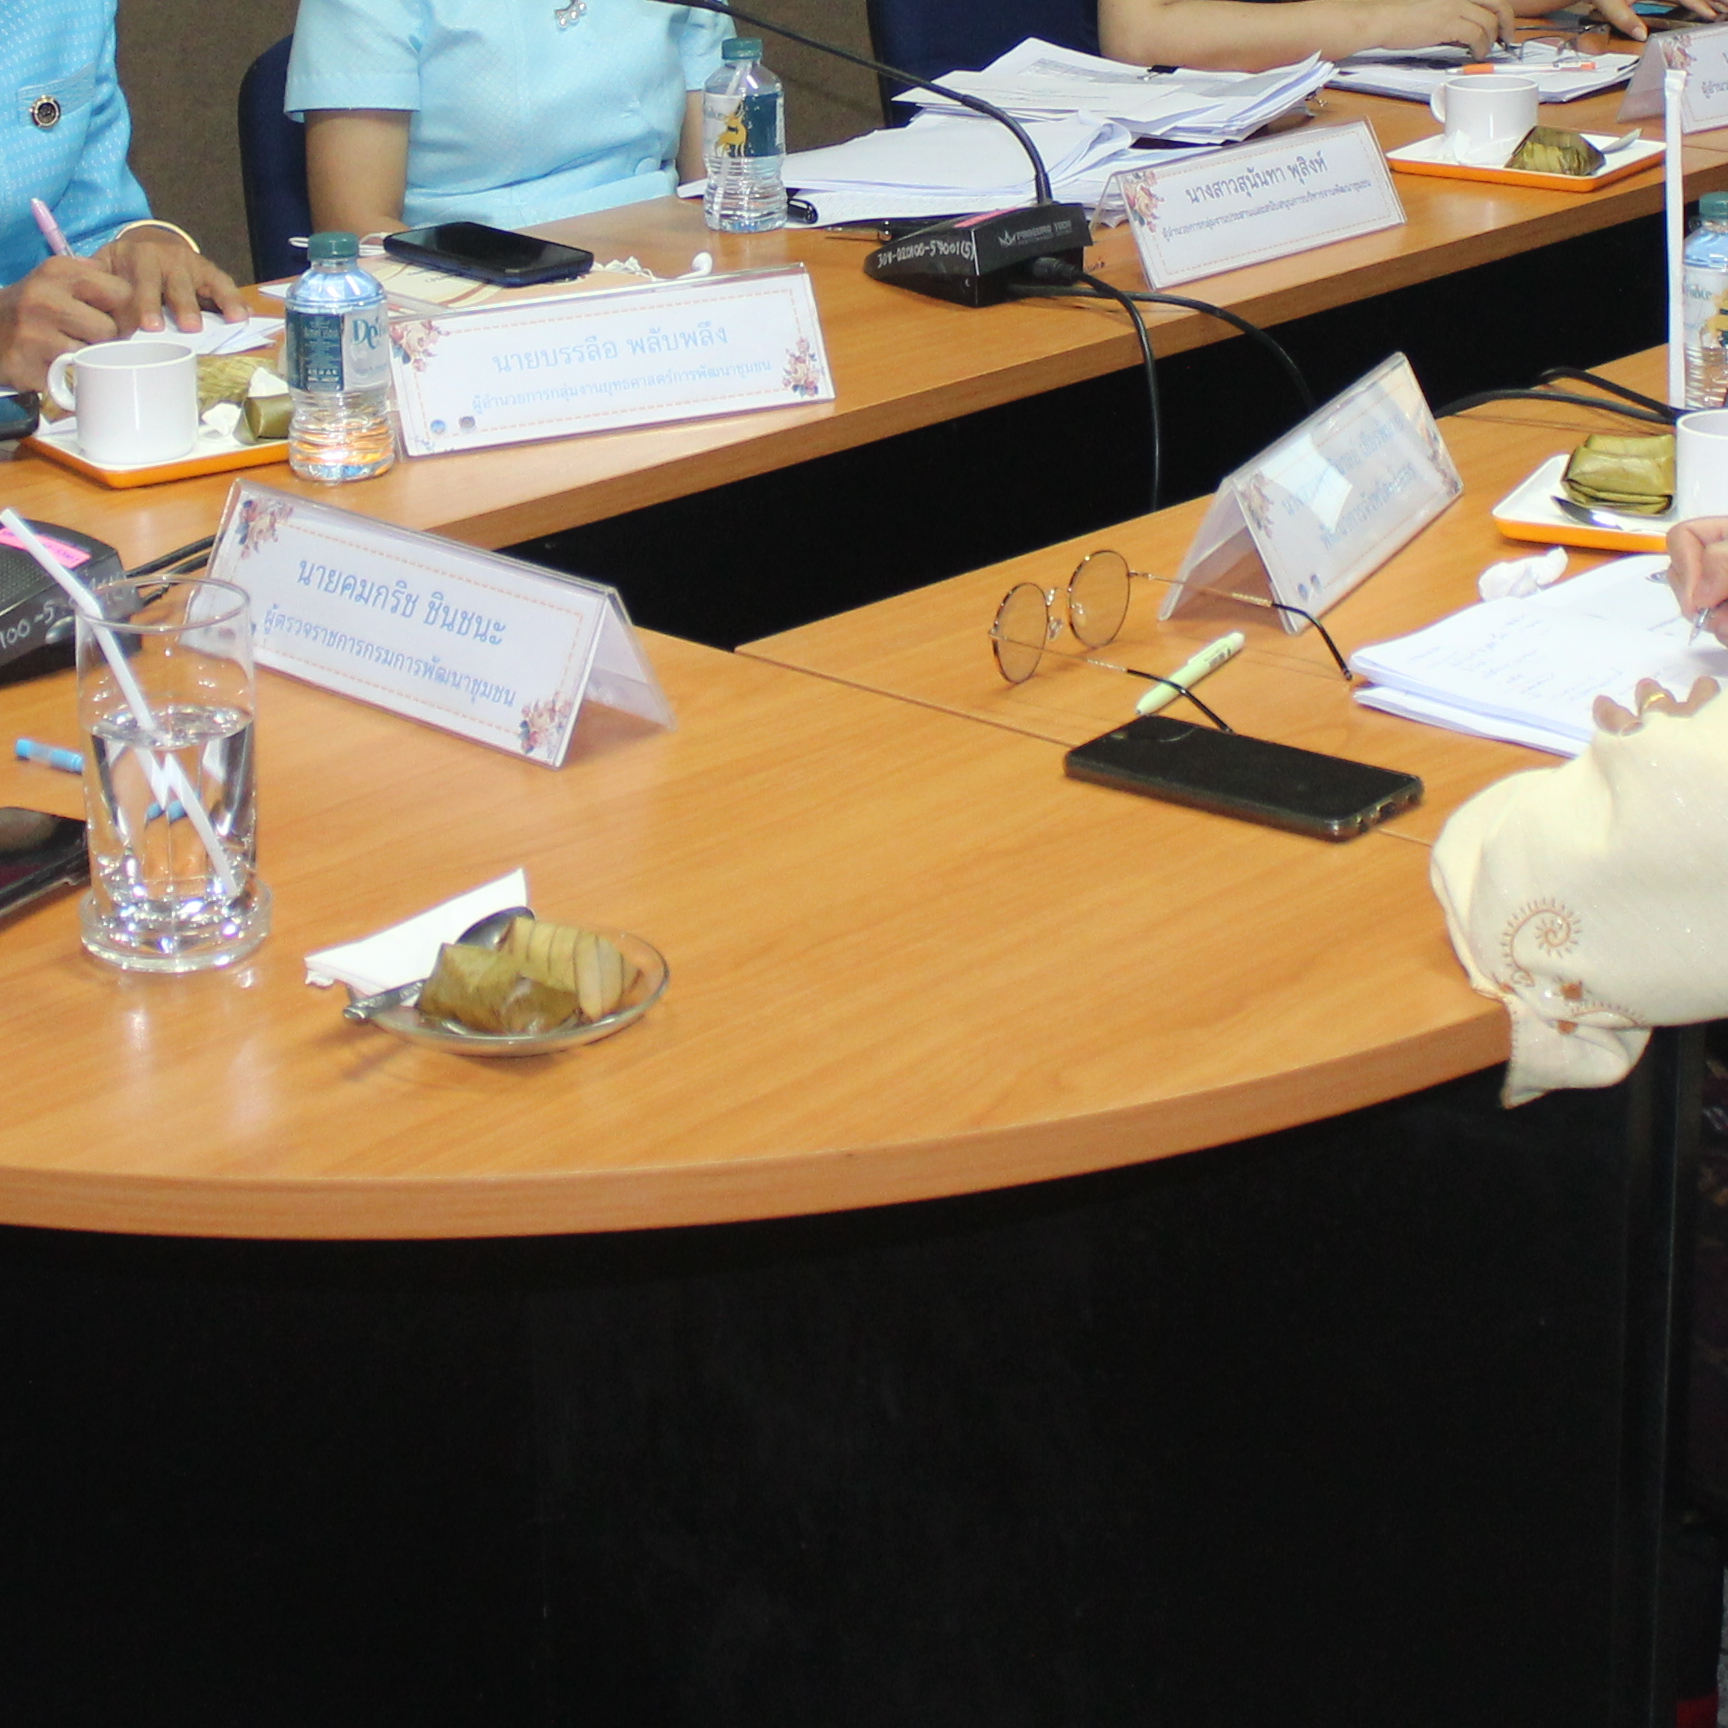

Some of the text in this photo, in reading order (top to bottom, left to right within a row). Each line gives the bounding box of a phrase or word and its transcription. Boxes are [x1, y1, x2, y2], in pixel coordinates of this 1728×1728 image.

[1184, 166, 1287, 205] นางสาวสุนันทา
[491, 334, 619, 374] นายบรรลือ
[296, 560, 507, 646] นายคมกริช ชินชนะ
[262, 602, 518, 707] ผู้ตรวจราชการกรมการพัฒนาชุมชน
